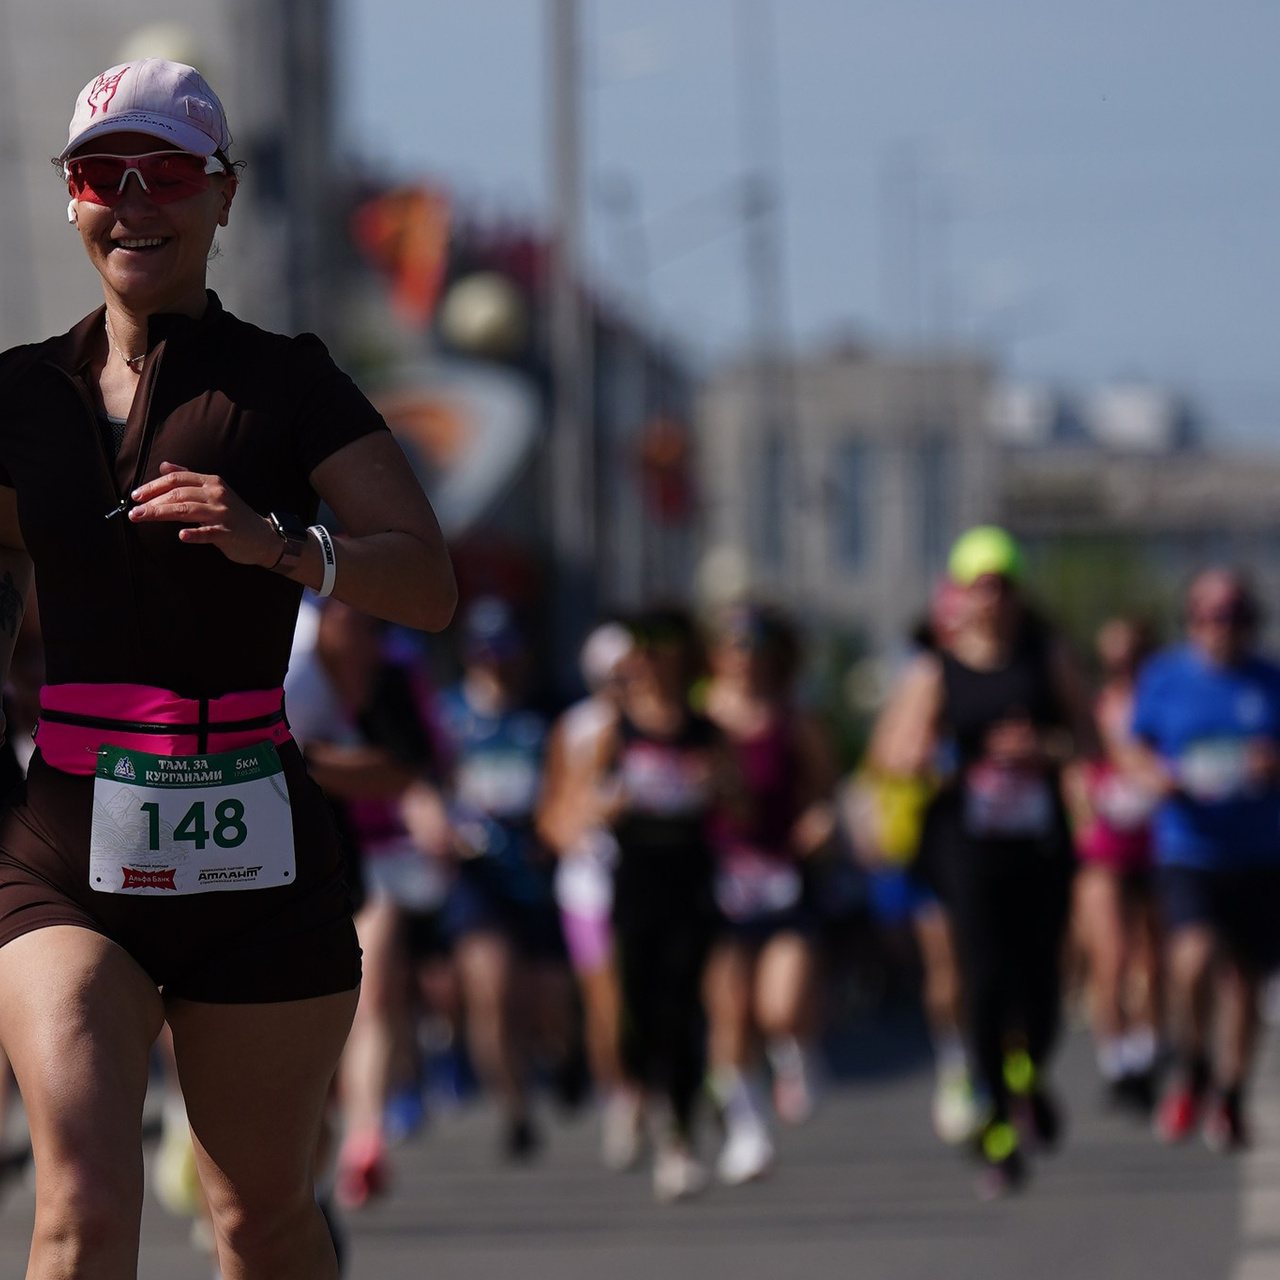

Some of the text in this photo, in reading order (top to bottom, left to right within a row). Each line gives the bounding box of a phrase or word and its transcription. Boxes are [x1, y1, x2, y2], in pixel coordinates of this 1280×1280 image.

[158, 759, 209, 771] ТАМ, ЗА
[145, 770, 223, 783] КУРГАНАМИ
[140, 798, 248, 851] 148
[128, 874, 170, 884] Альфа Банк
